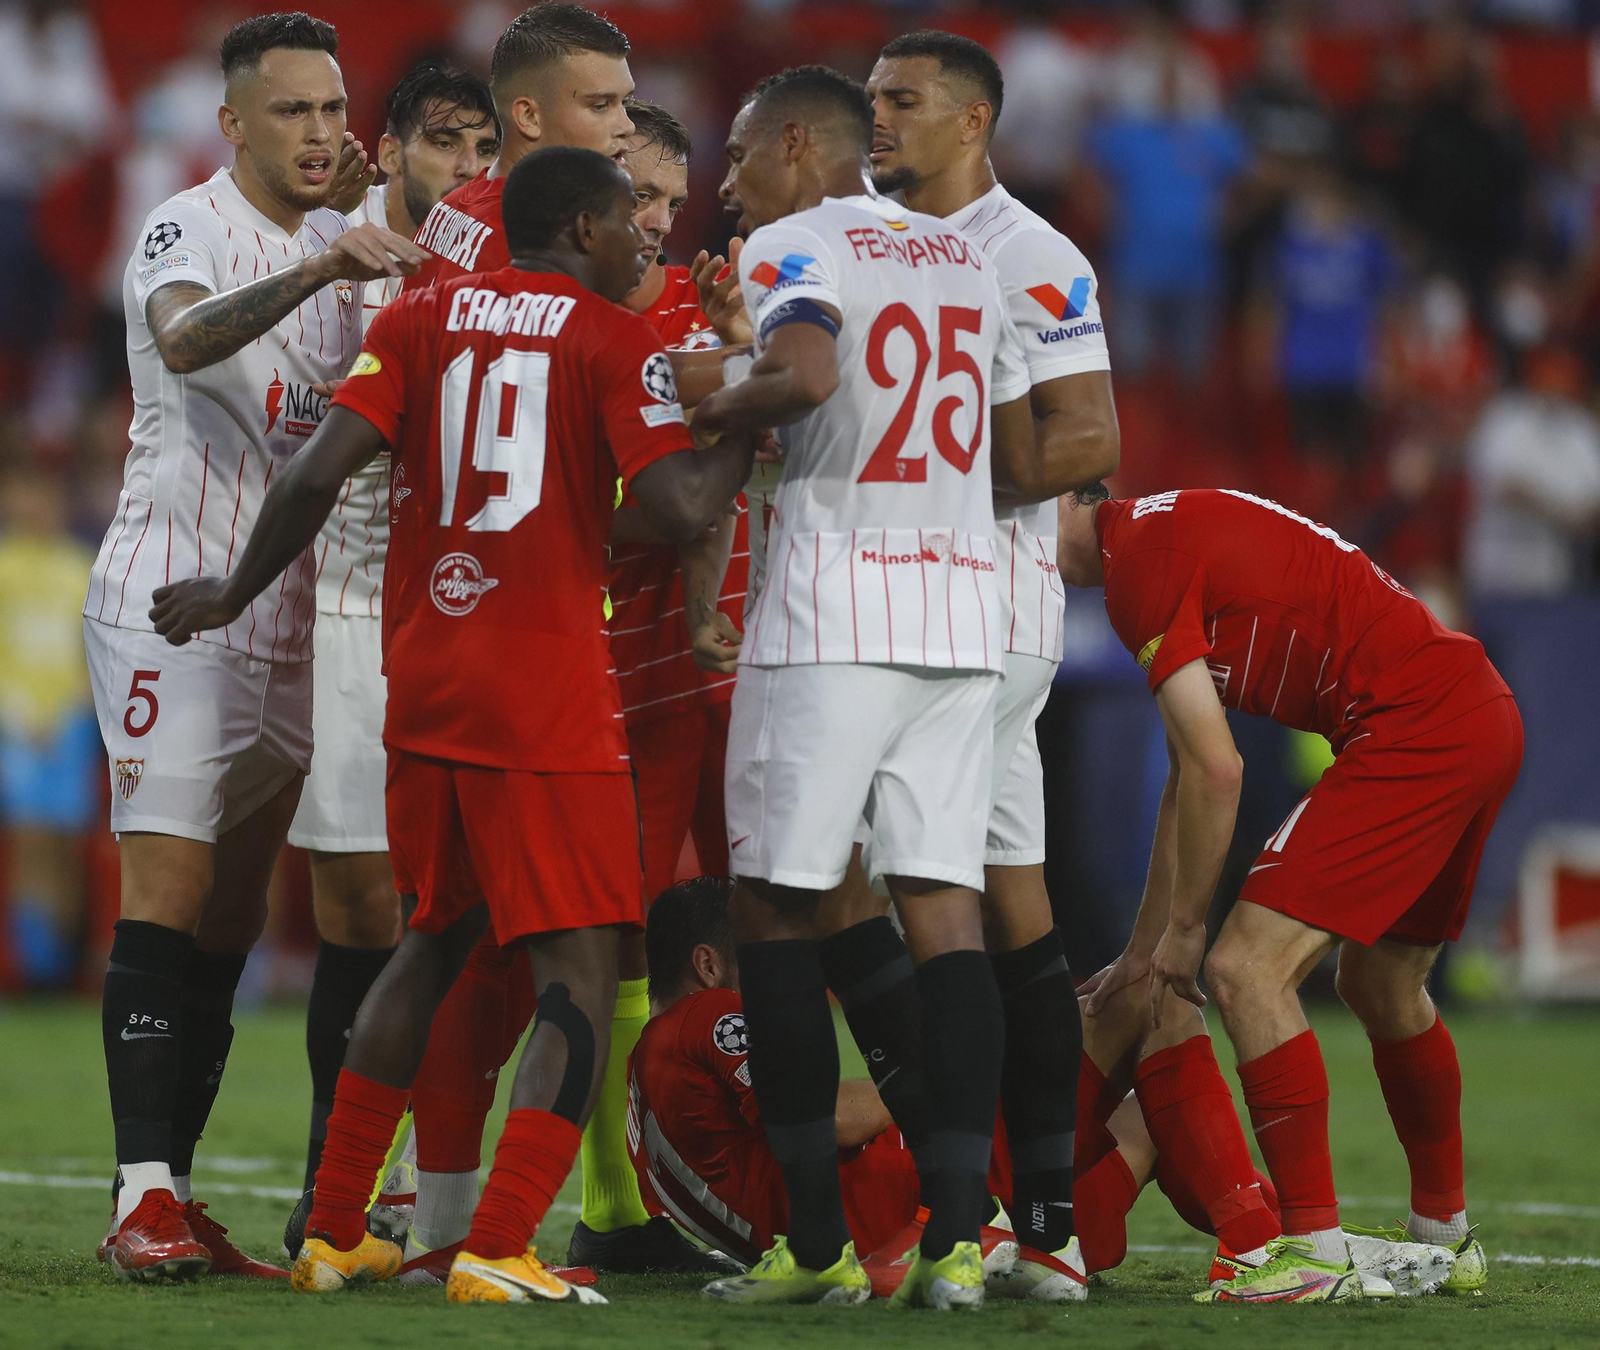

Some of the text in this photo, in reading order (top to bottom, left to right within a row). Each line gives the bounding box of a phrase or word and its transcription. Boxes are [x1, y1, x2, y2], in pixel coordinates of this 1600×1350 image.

[844, 228, 982, 271] FERNANDO
[1037, 321, 1103, 345] Valvoline
[856, 301, 985, 484] 25
[439, 346, 551, 532] 19
[861, 550, 921, 565] Manos
[123, 669, 162, 738] 5
[128, 1013, 169, 1030] SFC
